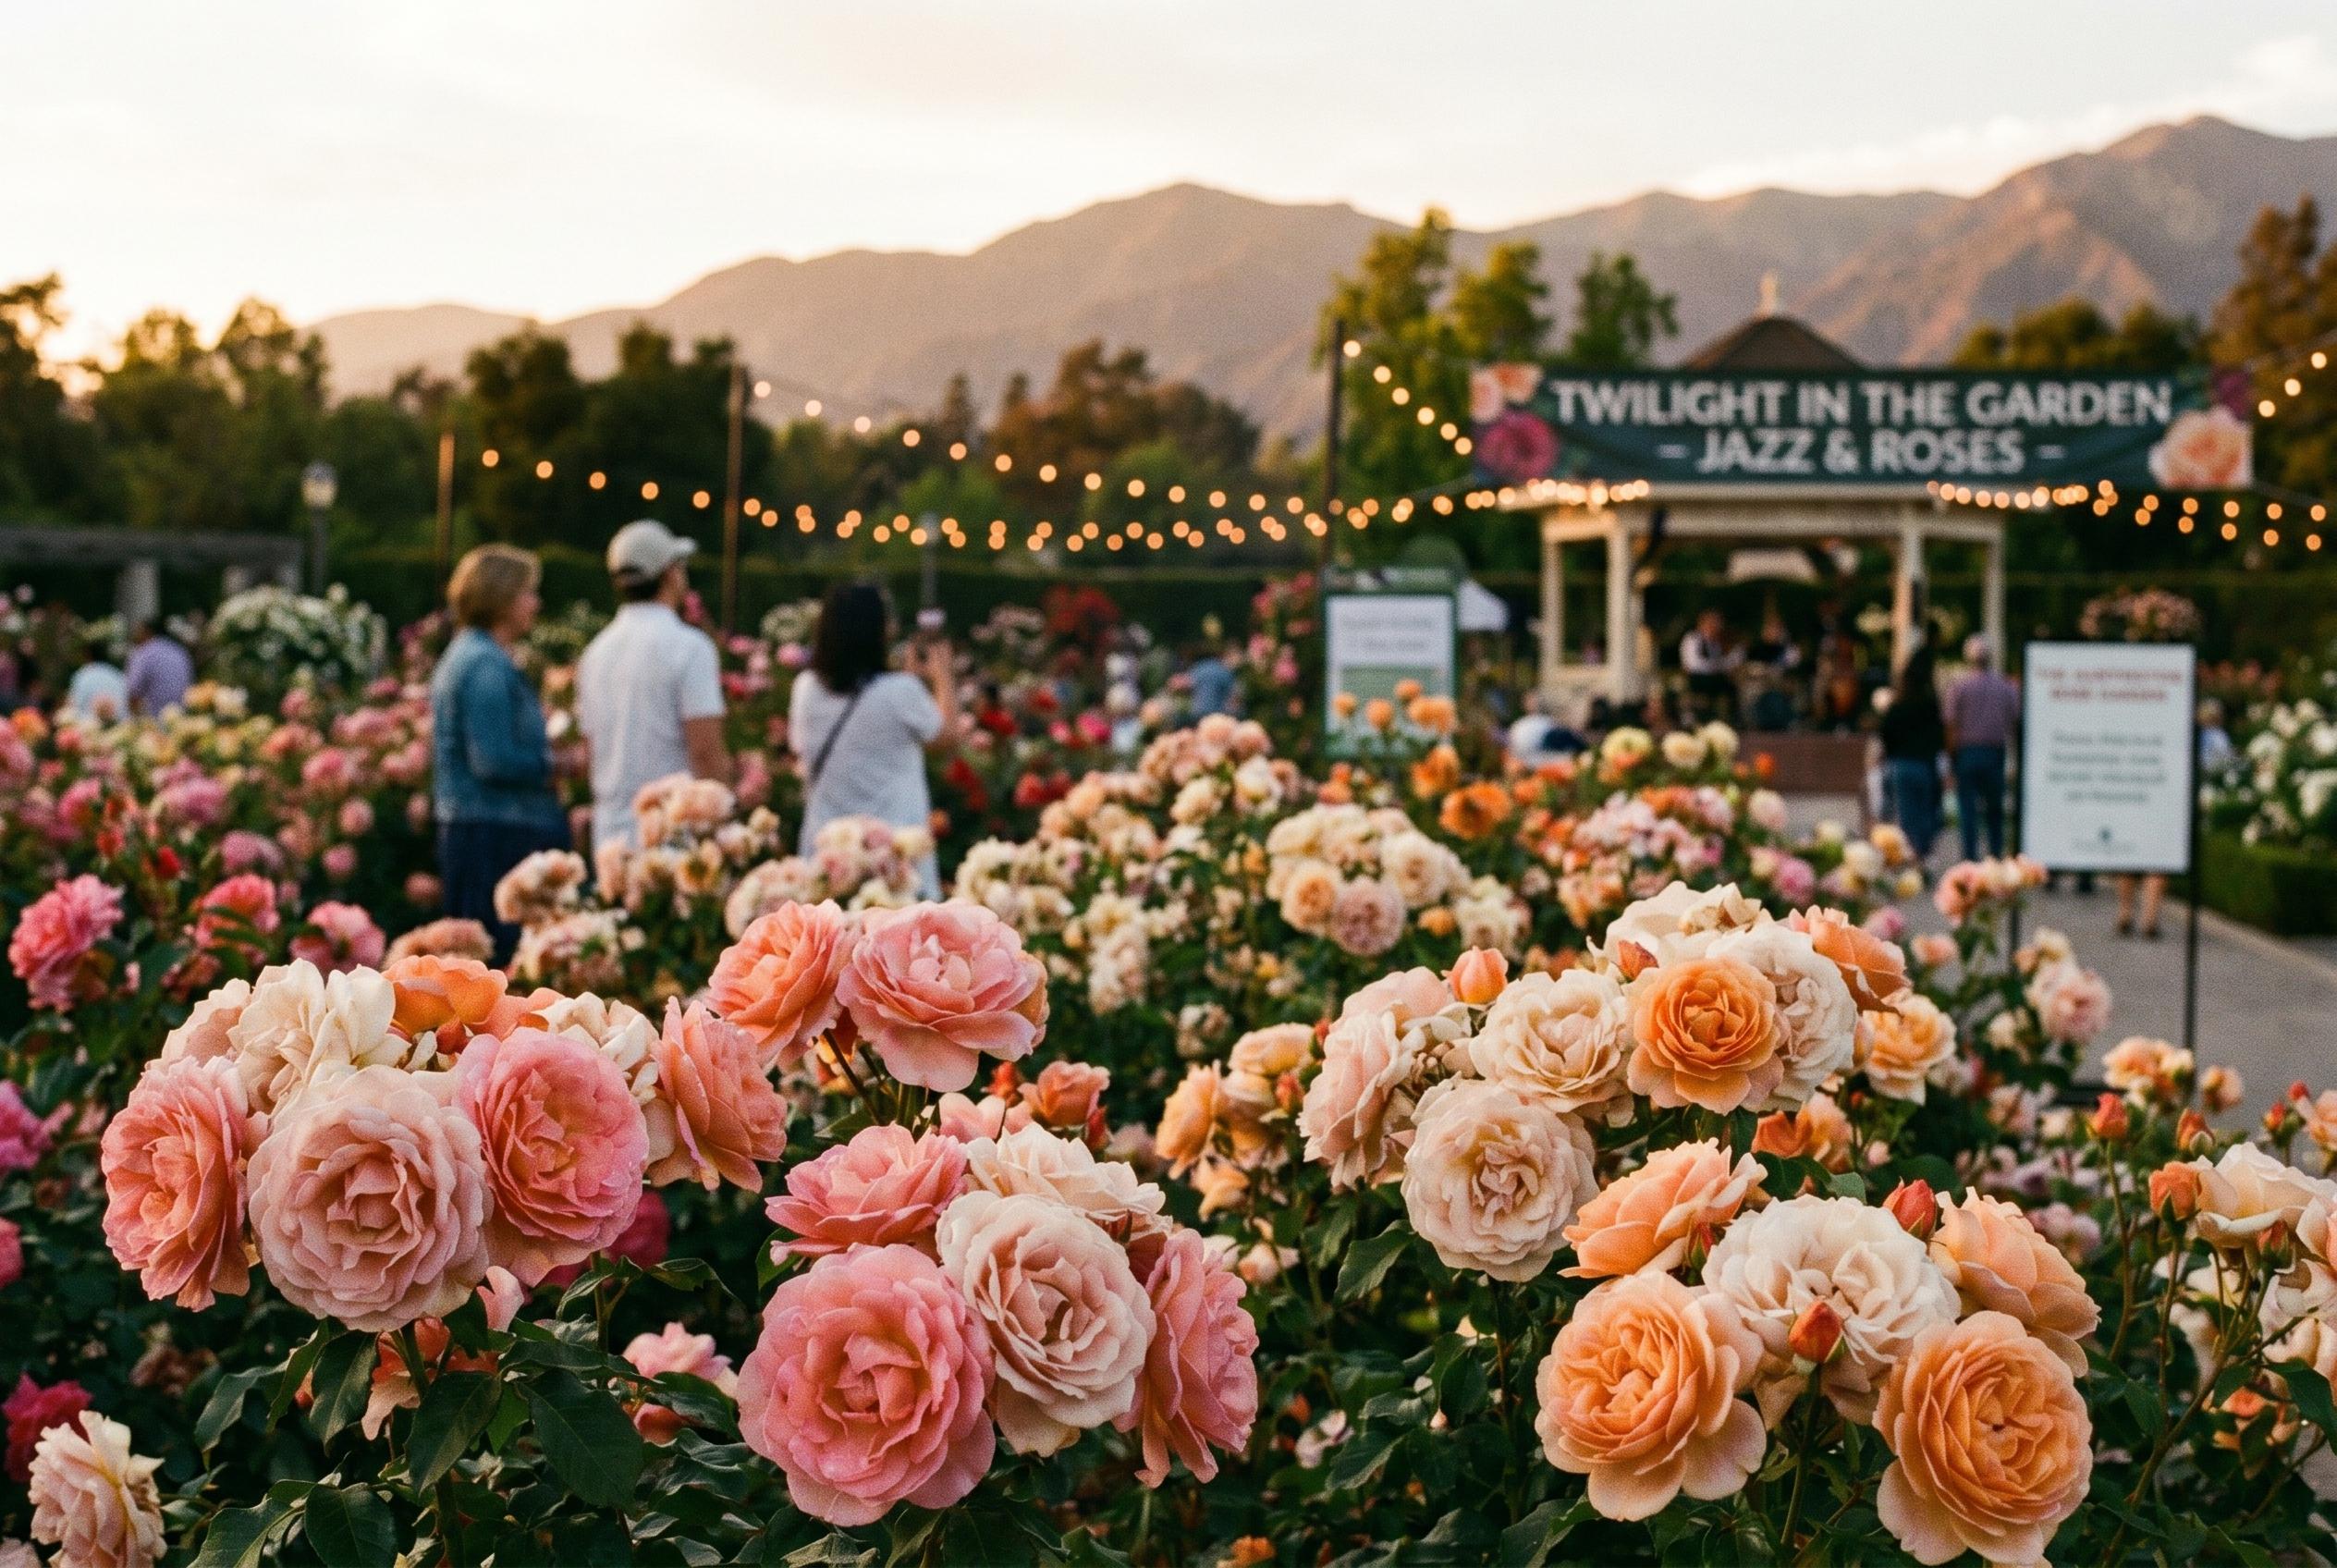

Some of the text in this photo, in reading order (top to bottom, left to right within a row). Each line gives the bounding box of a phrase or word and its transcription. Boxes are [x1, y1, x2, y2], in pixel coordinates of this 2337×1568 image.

[1552, 381, 2170, 425] TWILIGHT IN THE GARDEN
[1697, 428, 1814, 472] JAZZ
[1822, 428, 1859, 472] &
[1870, 428, 2025, 473] ROSES
